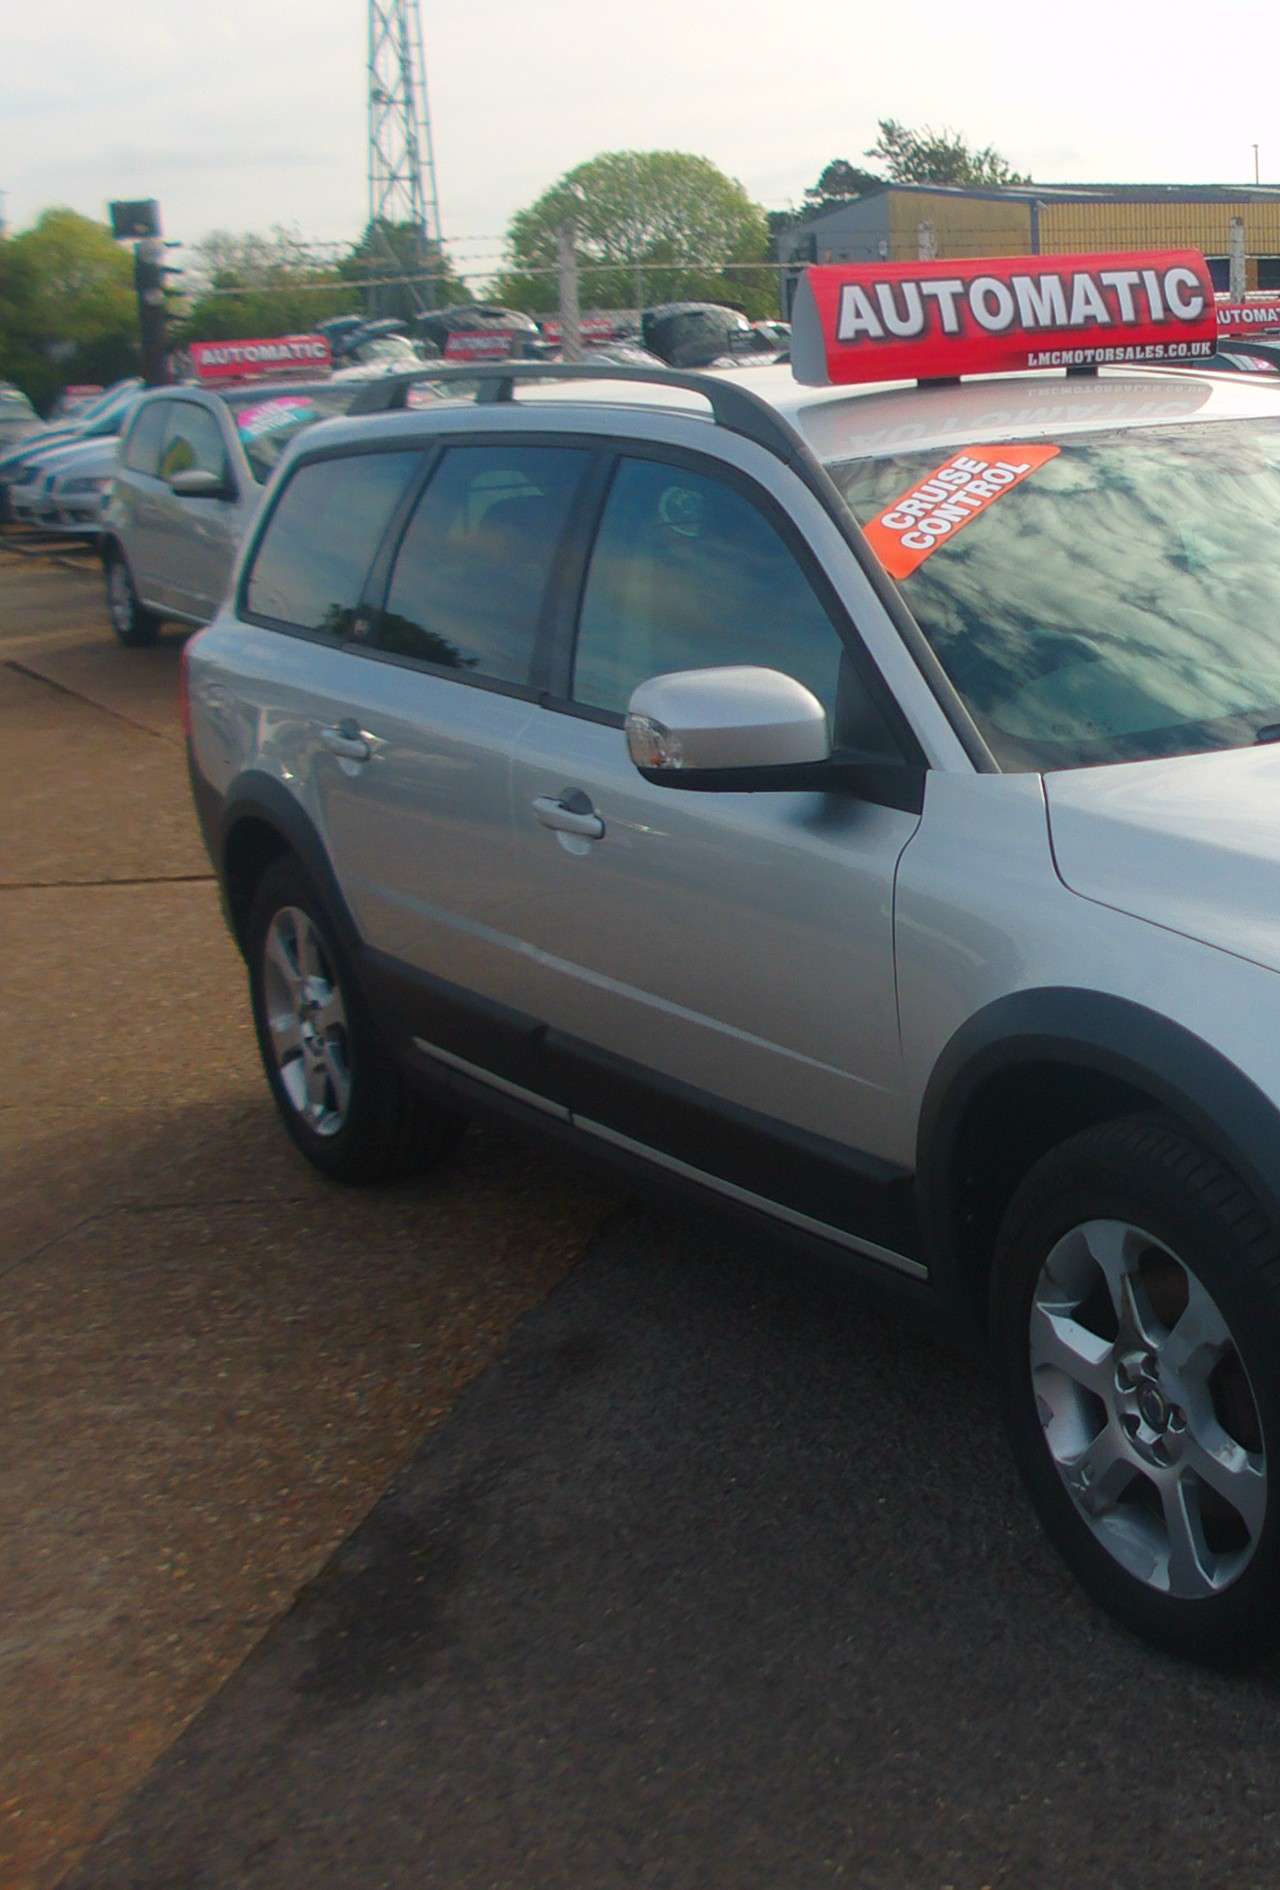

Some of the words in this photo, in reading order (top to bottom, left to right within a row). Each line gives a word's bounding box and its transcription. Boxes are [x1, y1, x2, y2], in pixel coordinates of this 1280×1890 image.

[838, 267, 1204, 340] AUTOMATIC
[201, 342, 327, 364] AUTOMATIC
[1027, 341, 1212, 367] LMCMOTORSALES.CO.UK
[881, 456, 989, 530] CRUISE
[901, 462, 1031, 549] CONTROL
